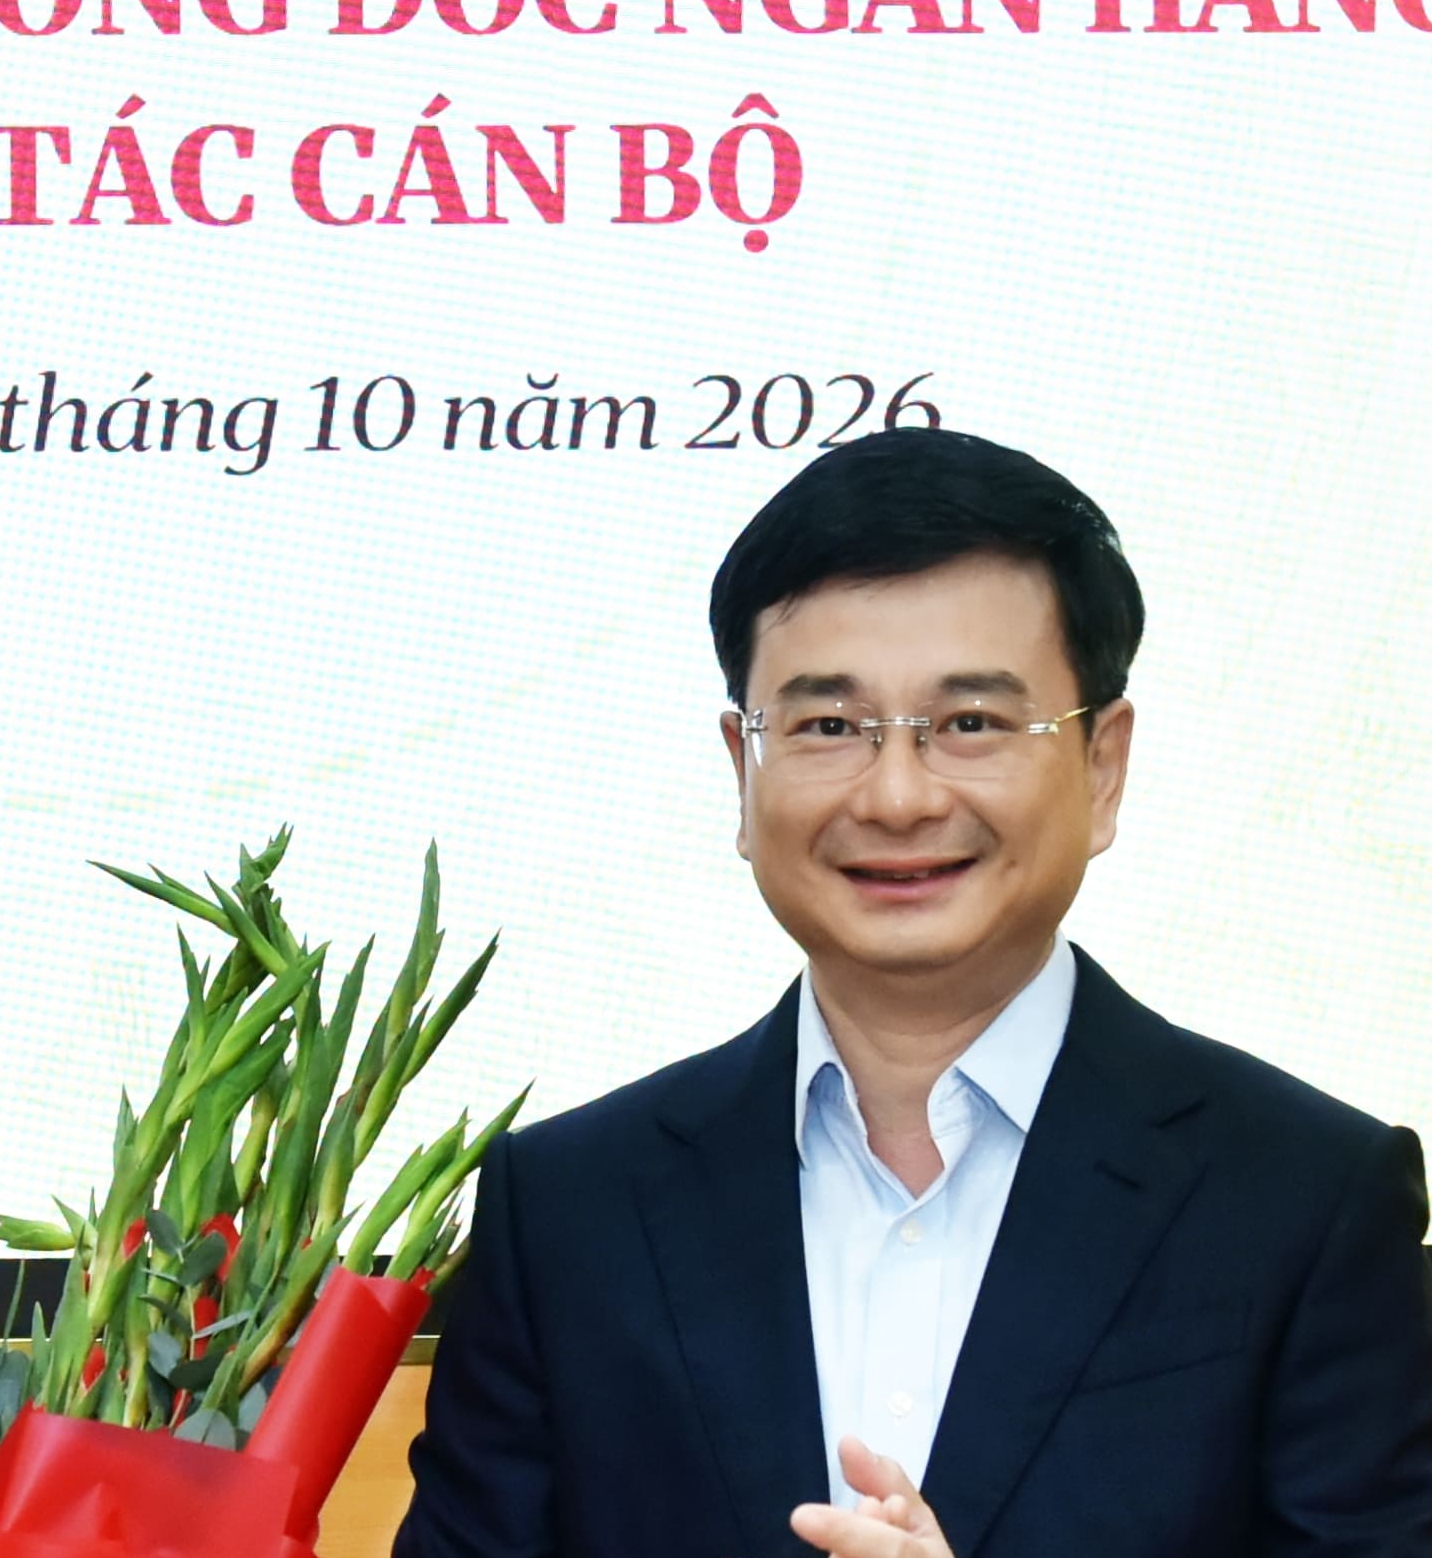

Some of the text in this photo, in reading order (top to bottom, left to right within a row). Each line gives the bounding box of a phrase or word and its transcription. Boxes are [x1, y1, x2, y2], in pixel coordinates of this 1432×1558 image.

[291, 93, 574, 227] CÁN
[610, 93, 803, 253] BỘ
[306, 376, 416, 453] 10
[443, 375, 659, 453] năm
[684, 371, 942, 450] 2026
